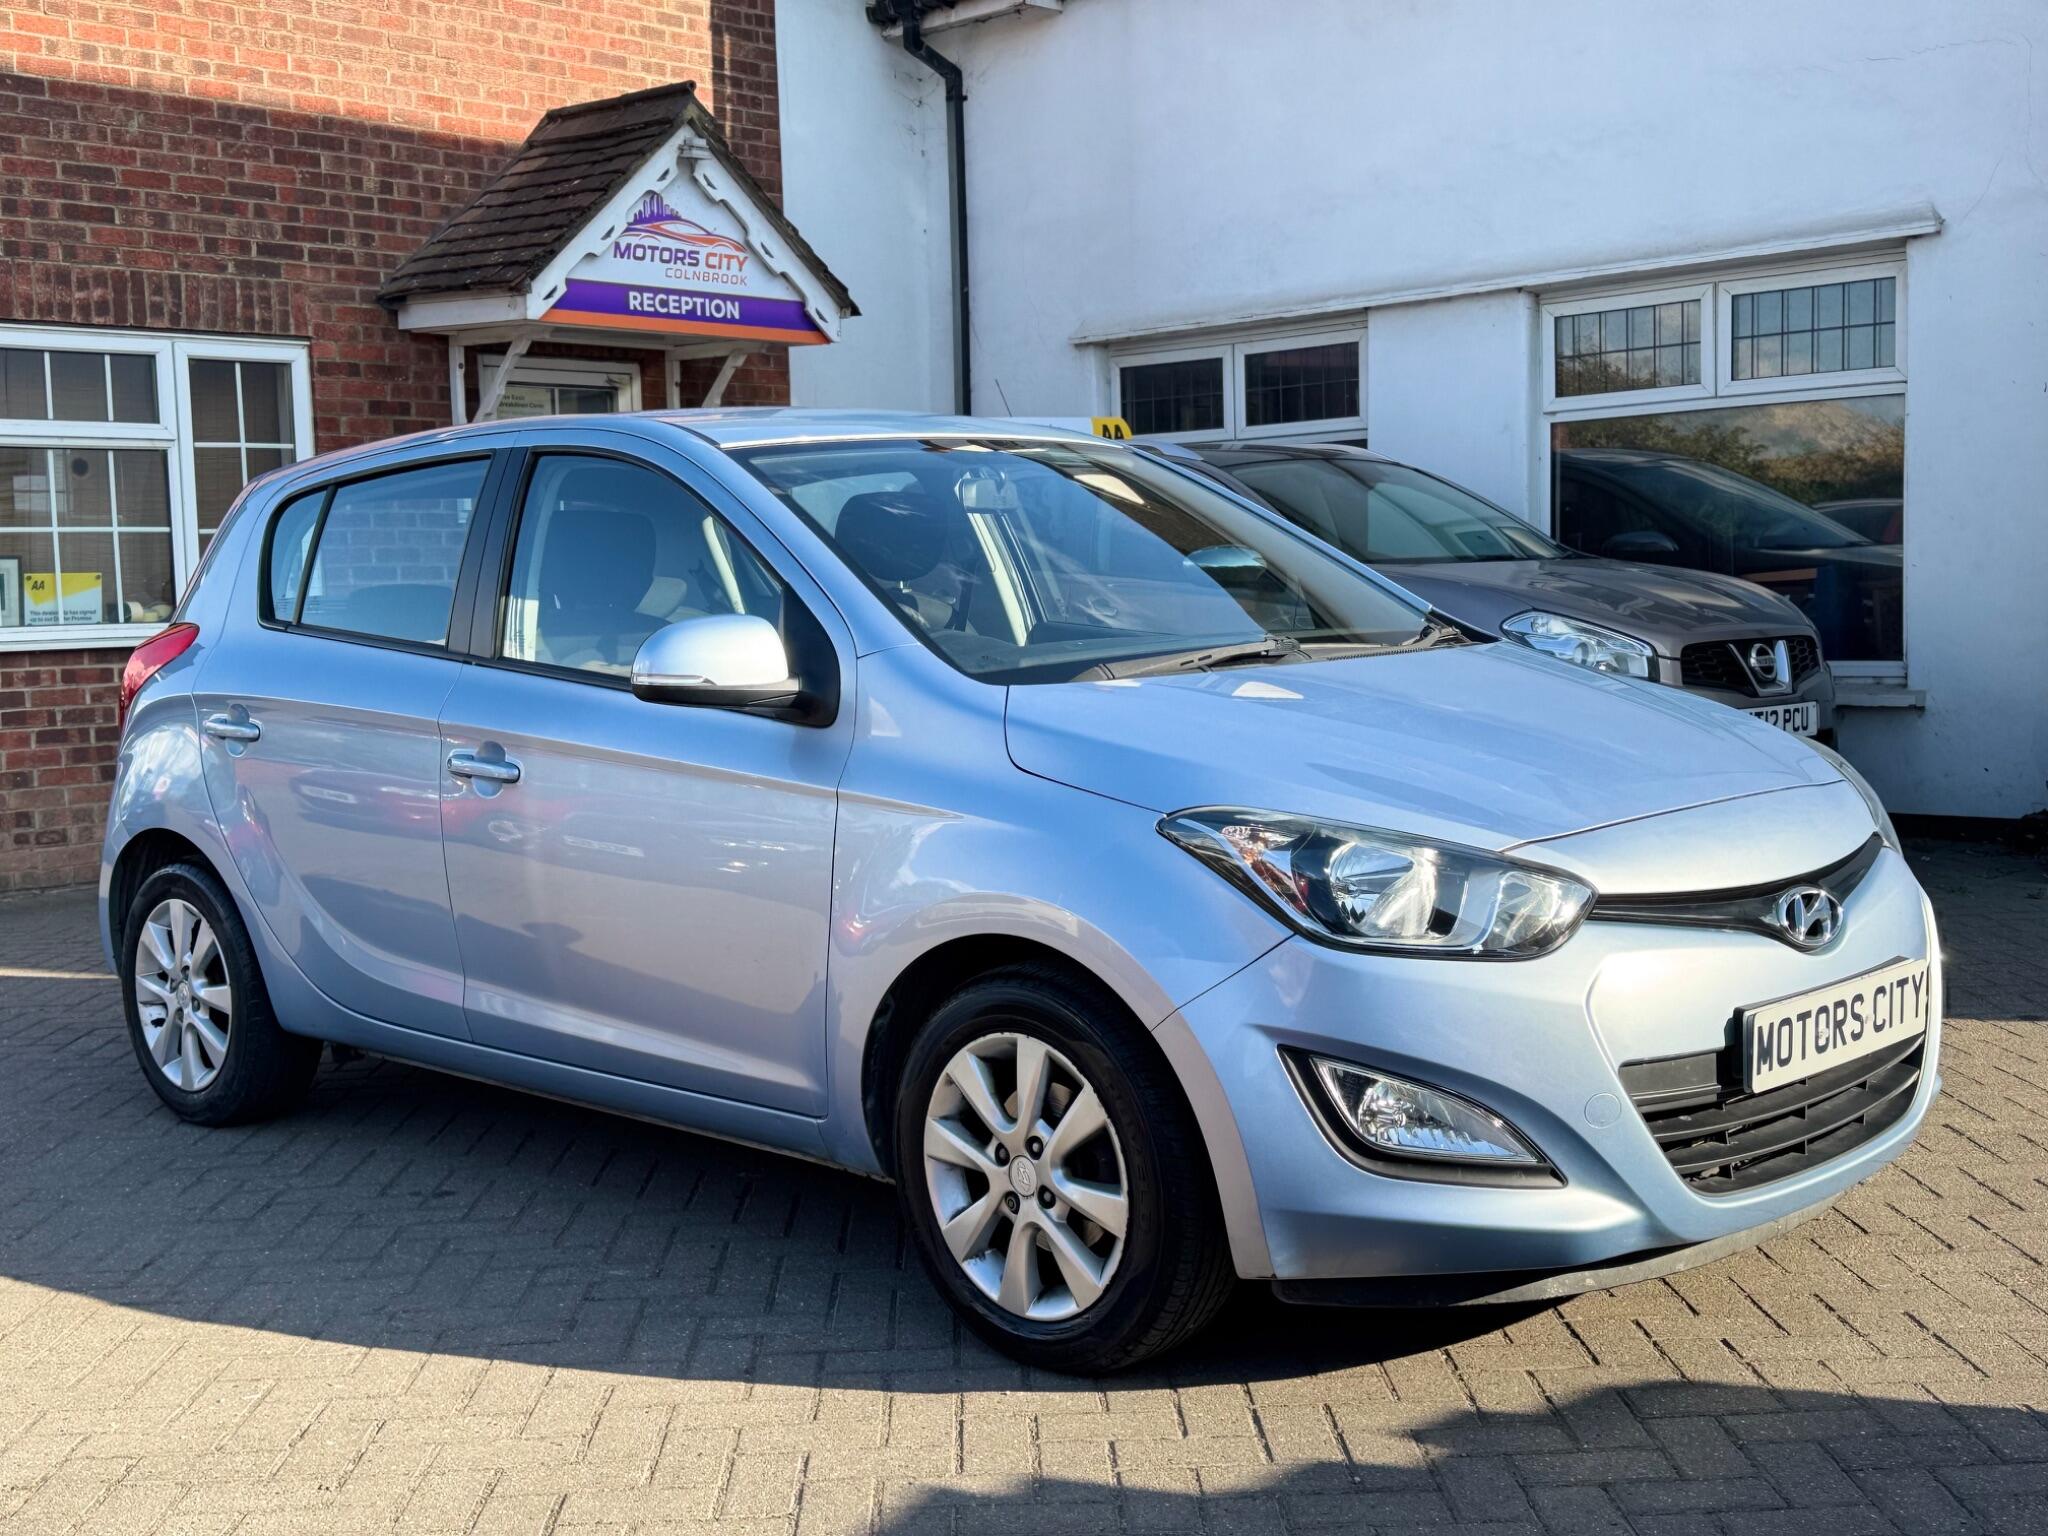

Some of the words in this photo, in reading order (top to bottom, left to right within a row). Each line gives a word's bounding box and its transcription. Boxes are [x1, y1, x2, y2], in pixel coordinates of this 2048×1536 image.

[613, 241, 700, 267] MOTORS
[704, 253, 748, 272] CITY
[665, 267, 748, 286] COLNBROOK
[628, 291, 740, 319] RECEPTION
[1102, 424, 1125, 440] AA
[31, 580, 45, 590] AA
[1783, 706, 1809, 732] PCU
[1756, 993, 1865, 1076] MOTORS
[1873, 971, 1925, 1033] CITY
